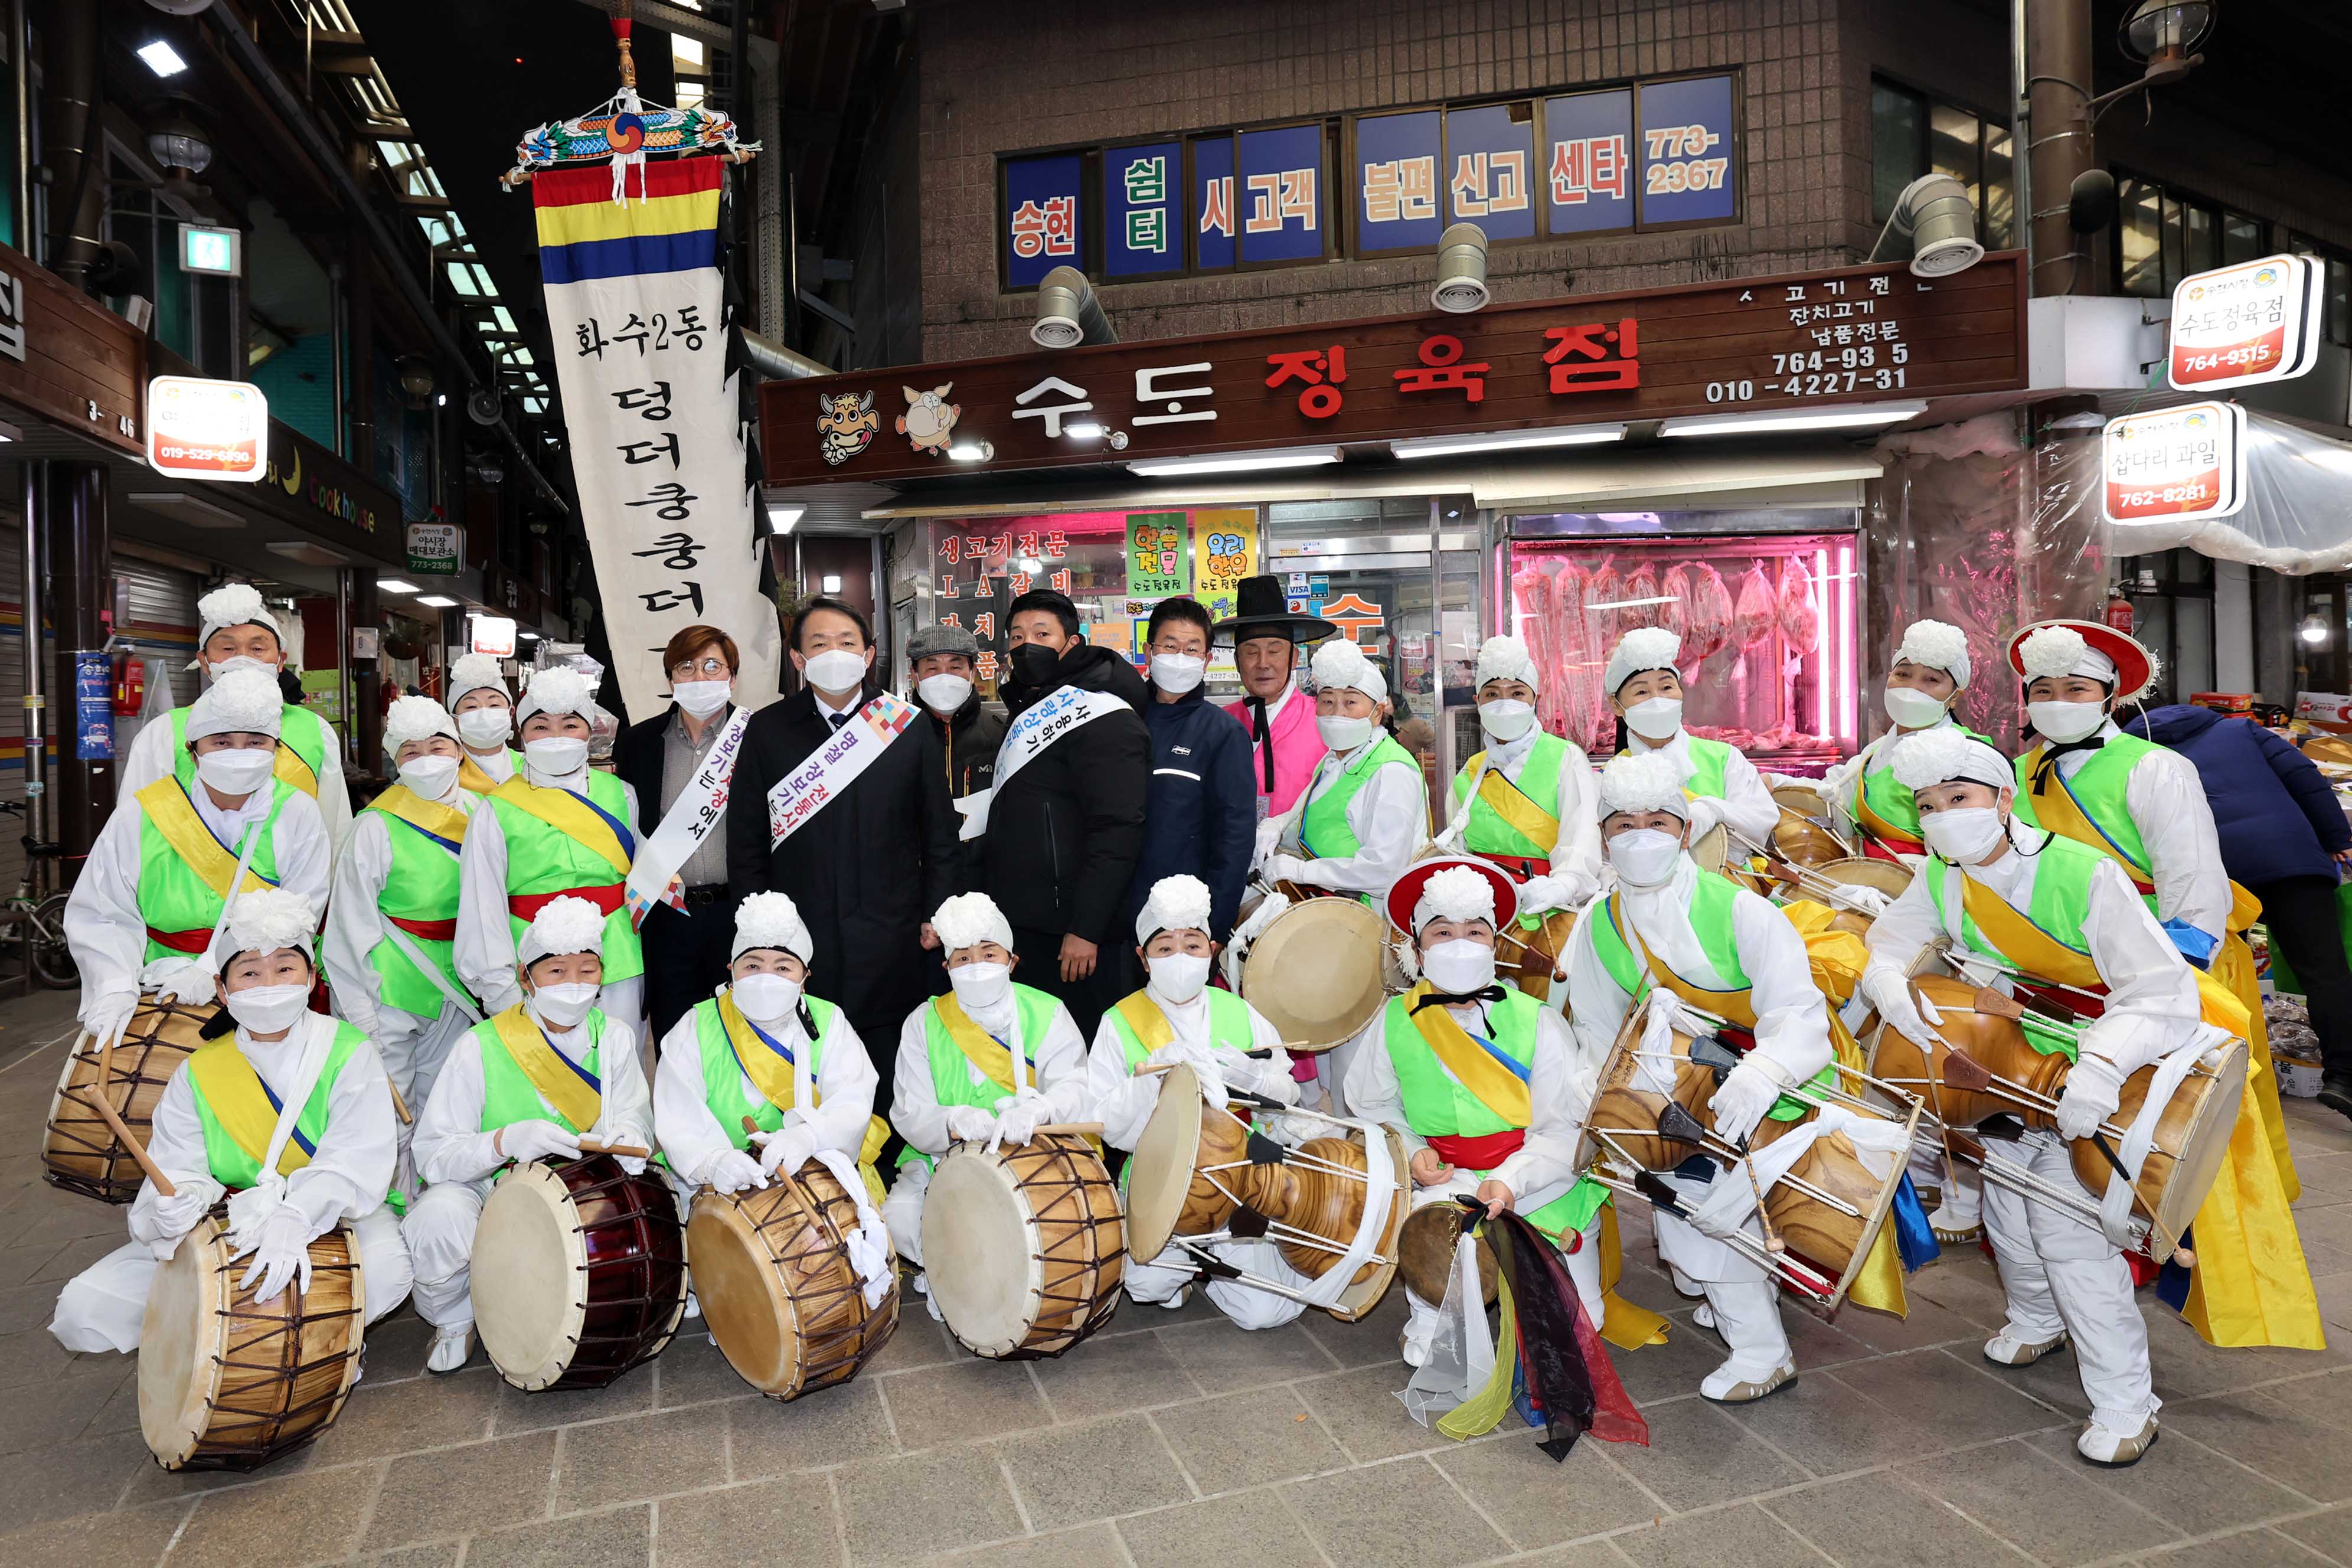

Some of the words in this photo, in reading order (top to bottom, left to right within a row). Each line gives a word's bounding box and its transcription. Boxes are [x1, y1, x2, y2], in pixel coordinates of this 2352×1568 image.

[1645, 124, 1719, 161] 773-
[1646, 157, 1729, 195] 2367
[1012, 196, 1076, 258] 송현
[1125, 156, 1167, 253] 쉼터
[1246, 168, 1316, 234] 고객
[1363, 155, 1436, 223] 불편
[1452, 149, 1528, 217] 신고
[1550, 134, 1628, 205] 센타
[1789, 300, 1874, 326] 잔치고기
[2179, 295, 2284, 338] 수도정육점
[576, 305, 707, 362] 화수2동
[1811, 321, 1899, 347] 납품전문
[2184, 344, 2270, 373] 764-9315
[2176, 439, 2215, 466] 과일
[2119, 484, 2207, 508] 762-8281
[409, 546, 454, 557] 매대보관소
[419, 536, 447, 547] 야시장
[610, 381, 707, 698] 덩더쿵쿵더
[939, 530, 1069, 564] 생고기전문
[1207, 533, 1245, 557] 우리
[411, 561, 453, 569] 773-2368
[1135, 550, 1178, 576] 전문
[1207, 553, 1247, 578] 한우
[1133, 579, 1181, 591] 수도정육점
[1201, 579, 1239, 590] 수도정육
[1026, 705, 1091, 754] 사용하기
[699, 724, 746, 789] 장보기는
[824, 730, 858, 765] 명절
[772, 783, 829, 845] 전통시장
